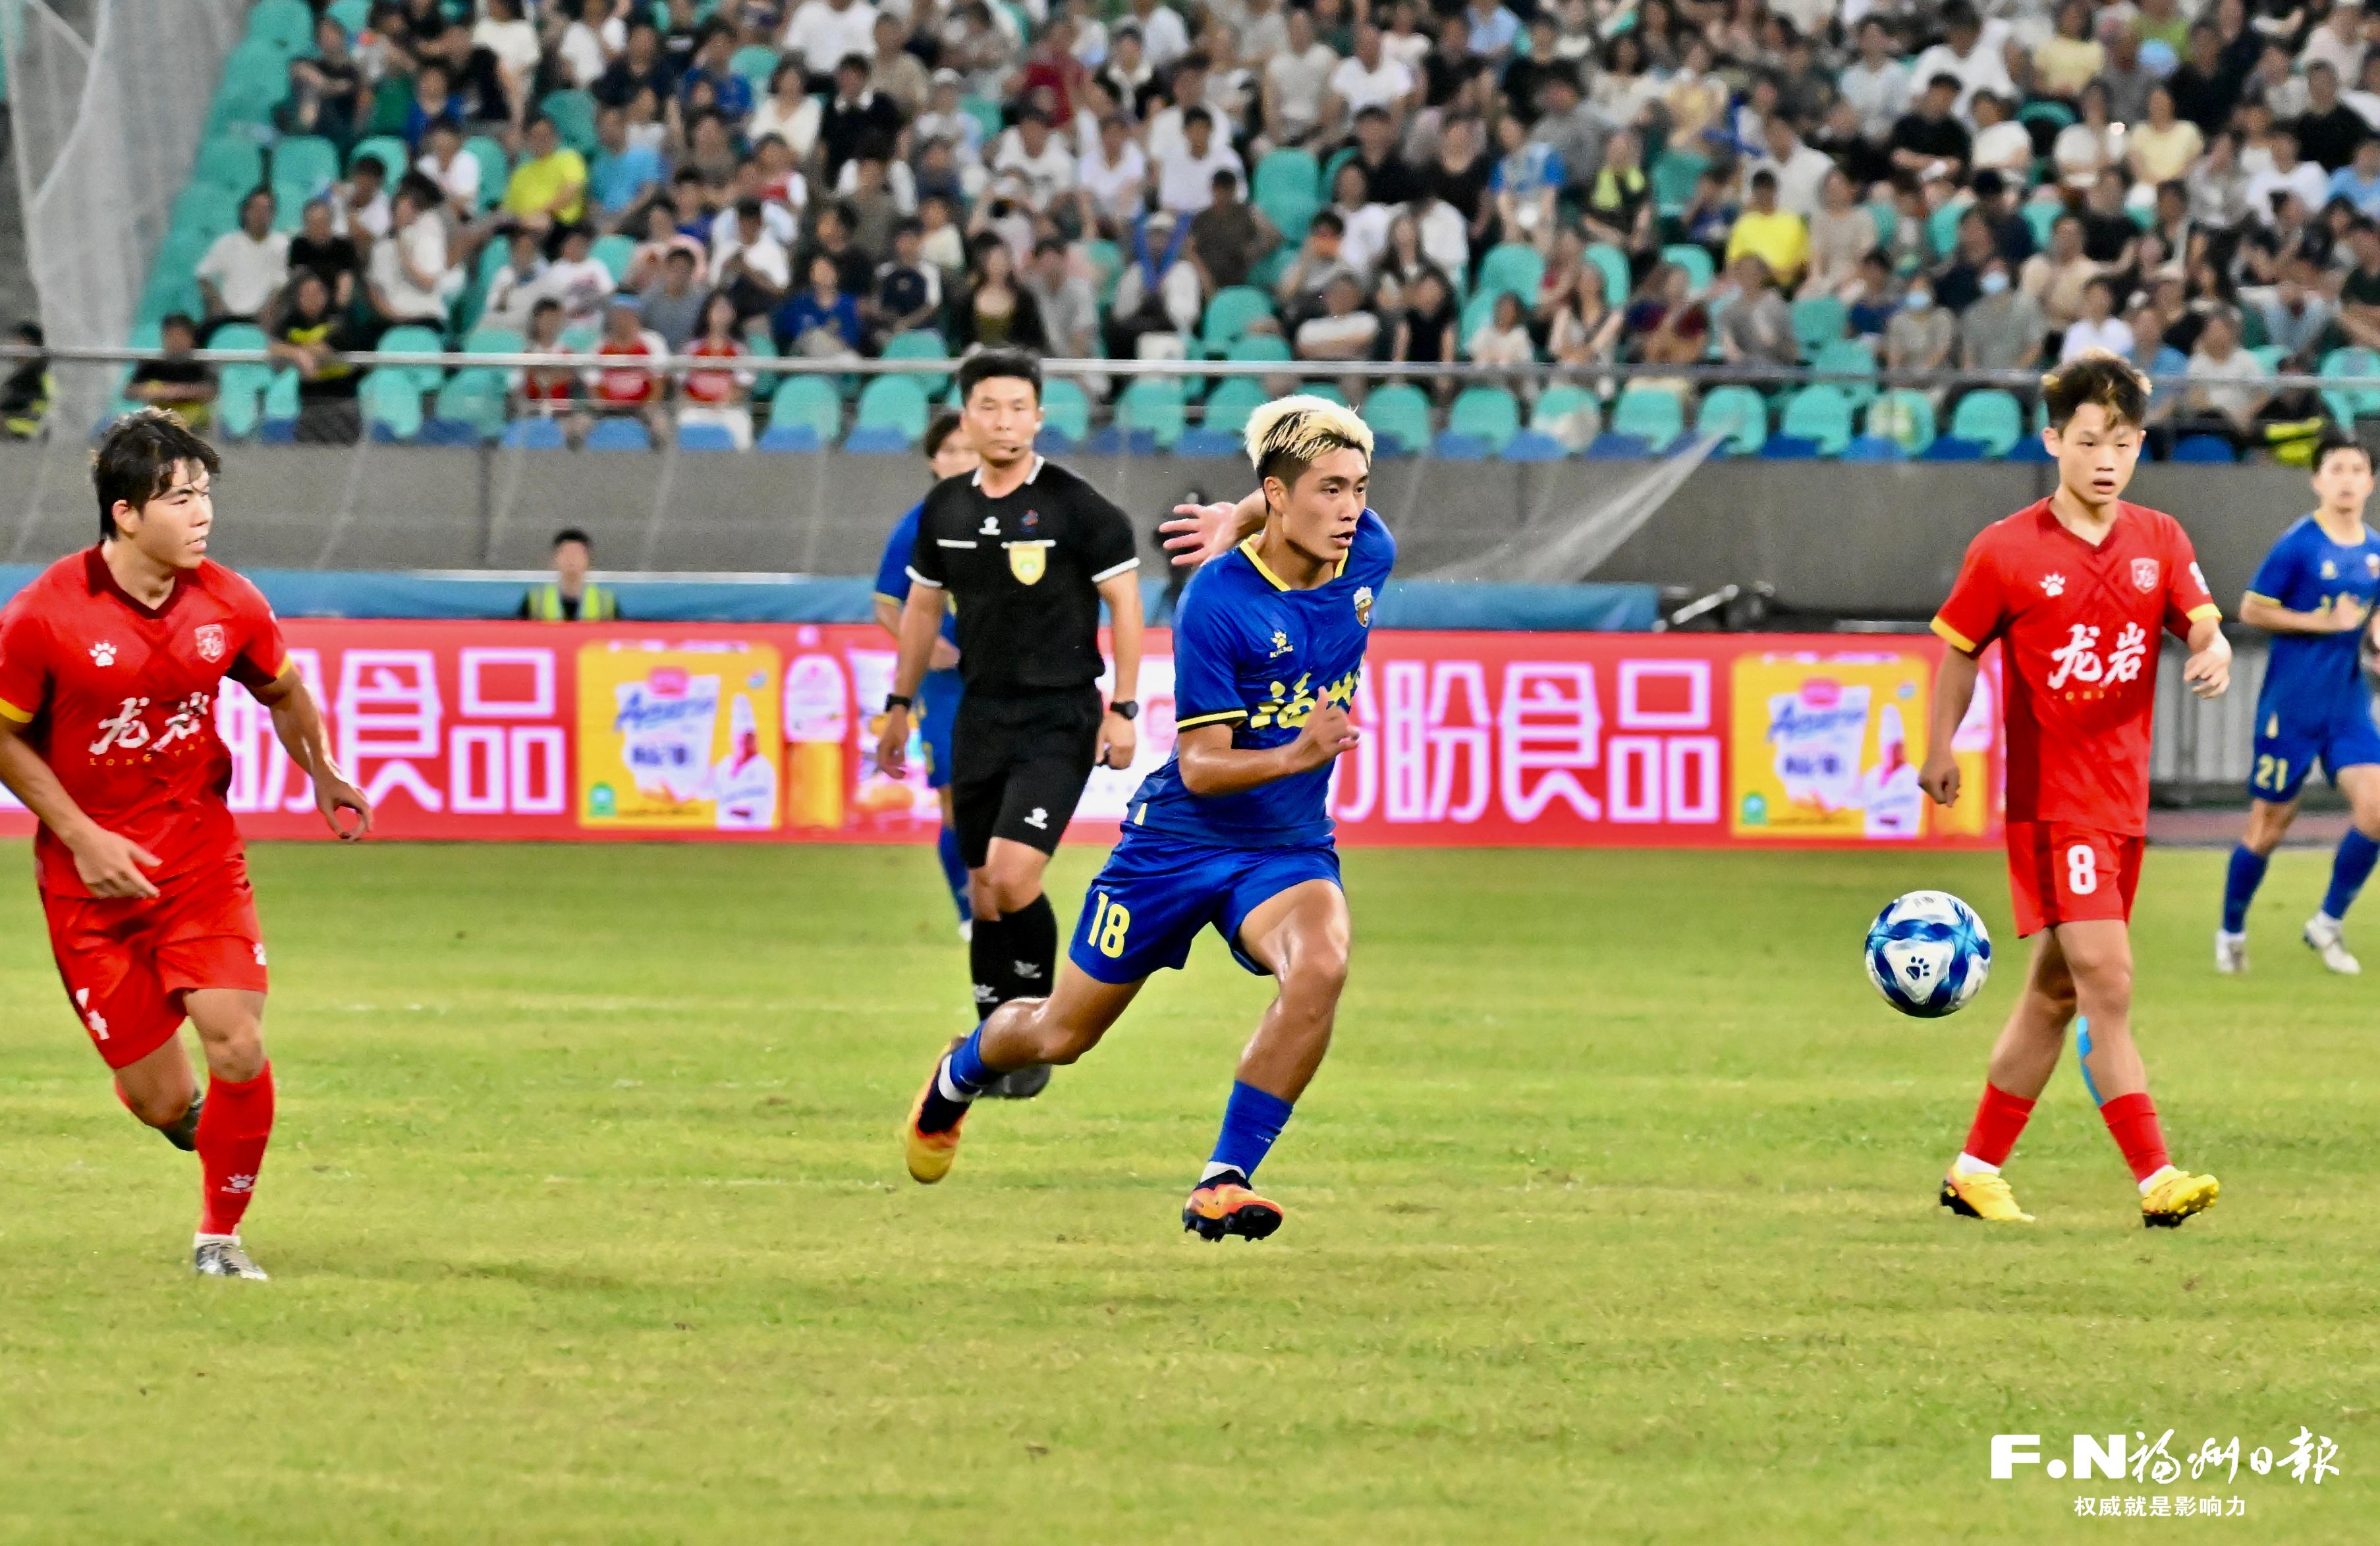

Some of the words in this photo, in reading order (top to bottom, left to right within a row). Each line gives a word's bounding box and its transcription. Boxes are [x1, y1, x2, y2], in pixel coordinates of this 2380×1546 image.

[2047, 622, 2146, 690] 龙岩
[2255, 753, 2289, 792] 21
[2067, 844, 2097, 895] 8
[1088, 891, 1130, 958] 18
